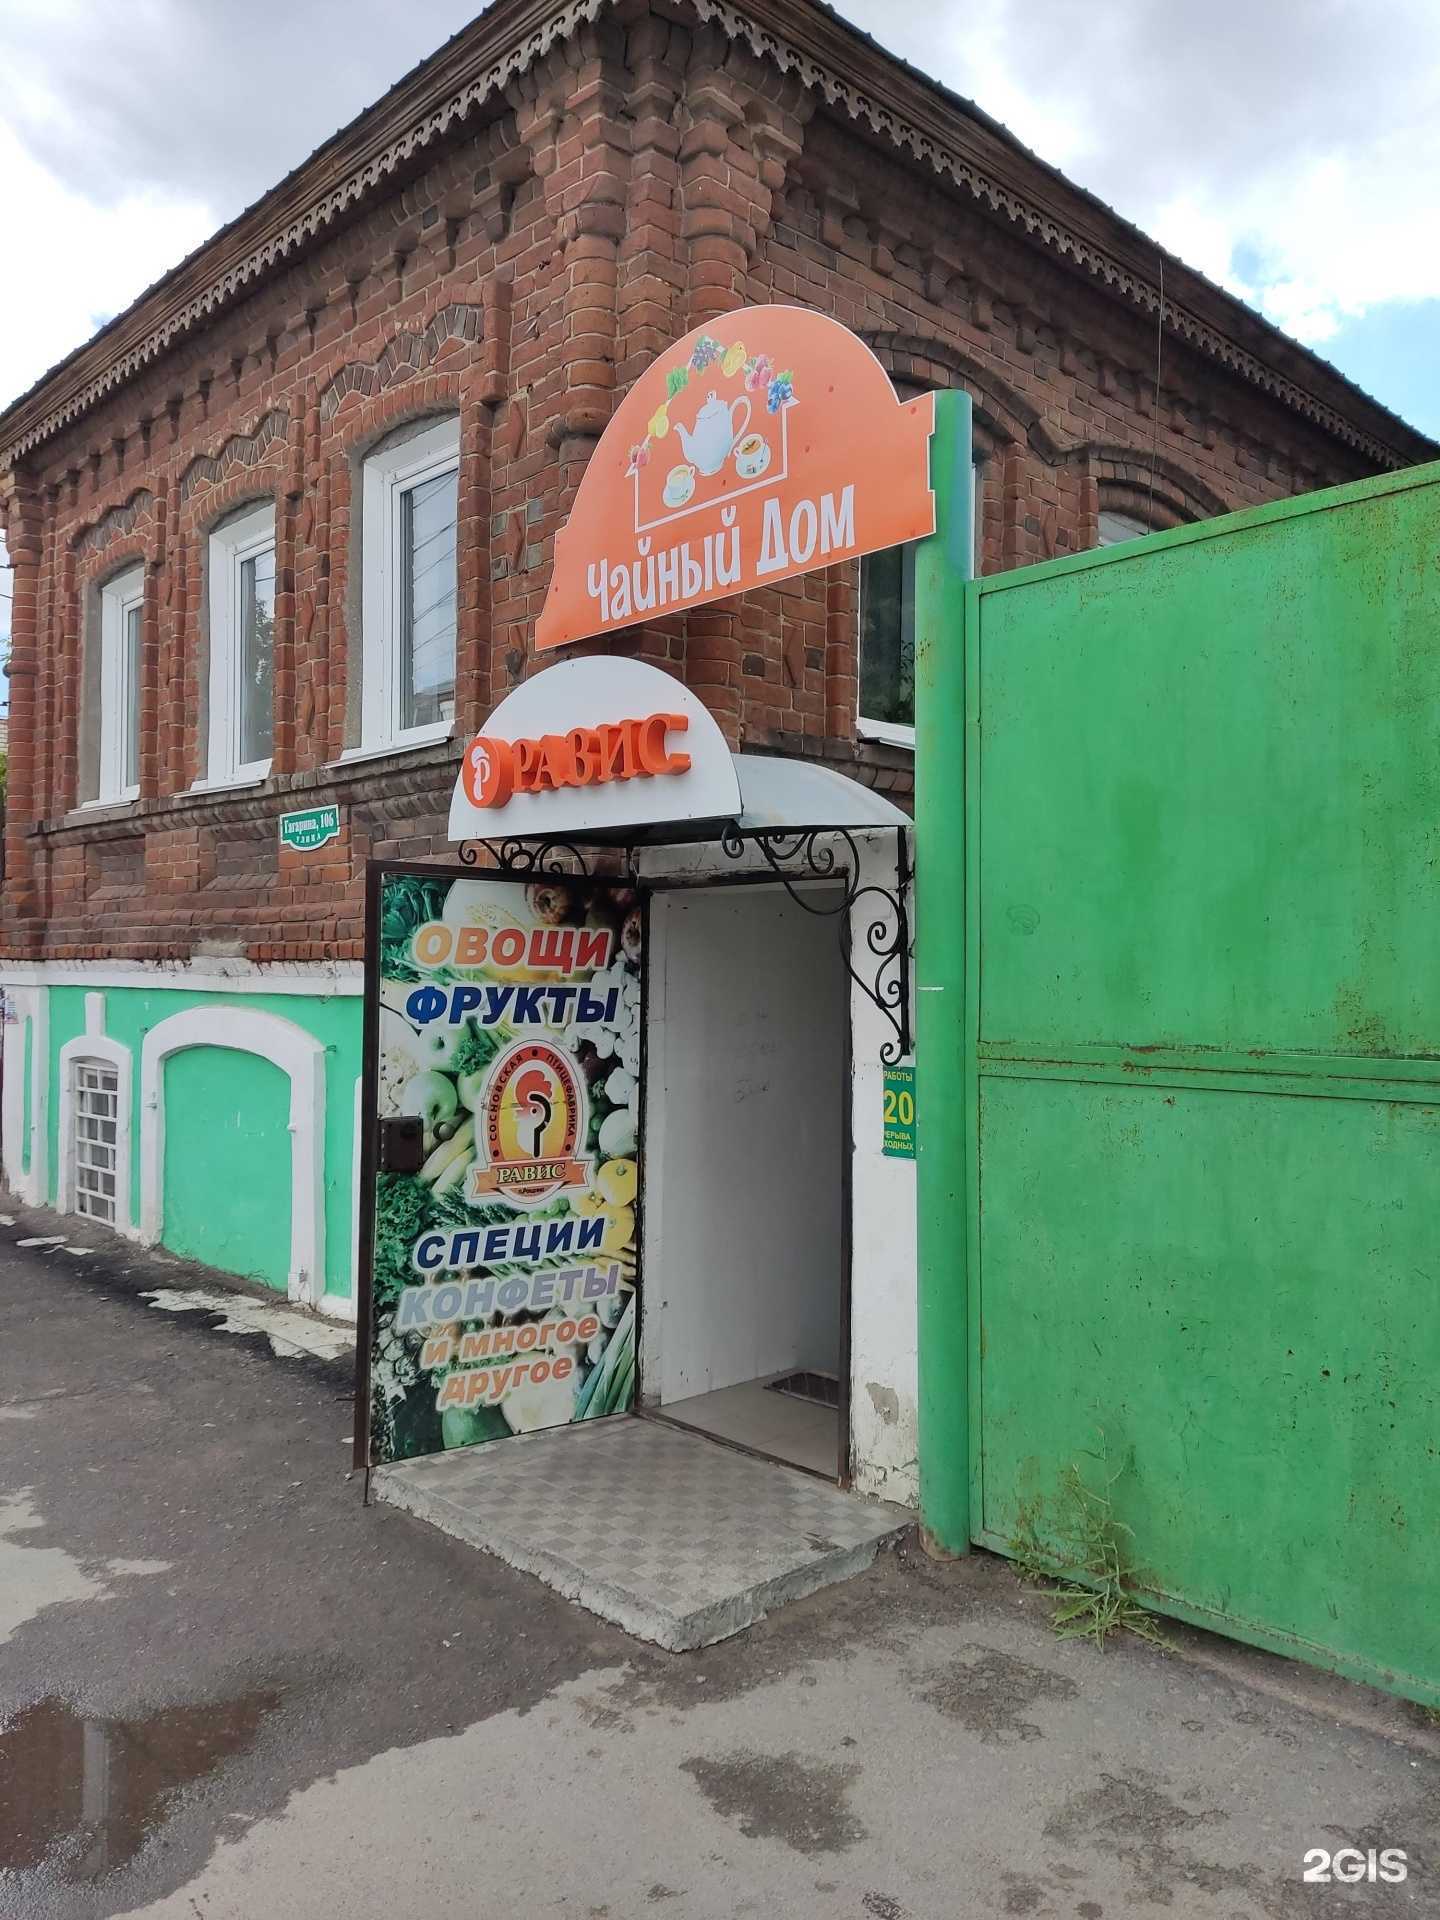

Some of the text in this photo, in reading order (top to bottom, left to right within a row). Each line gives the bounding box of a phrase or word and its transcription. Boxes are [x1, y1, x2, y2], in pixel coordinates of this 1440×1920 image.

[511, 713, 691, 794] РАВИС
[320, 812, 334, 828] 106
[415, 925, 610, 974] ОВОЩИ
[405, 985, 620, 1025] ФРУКТЫ
[489, 1054, 523, 1141] СОСНОВСКАЯ
[546, 1054, 577, 1137] ПТИЦЕФАБРИКА
[883, 1089, 914, 1125] 20
[884, 1130, 911, 1141] ЕРЫВА
[496, 1163, 567, 1185] РАВИС
[416, 1217, 605, 1269] СПЕЦИИ
[401, 1264, 619, 1326] КОНФЕТЫ
[461, 1316, 599, 1360] многое
[440, 1356, 573, 1407] другое
